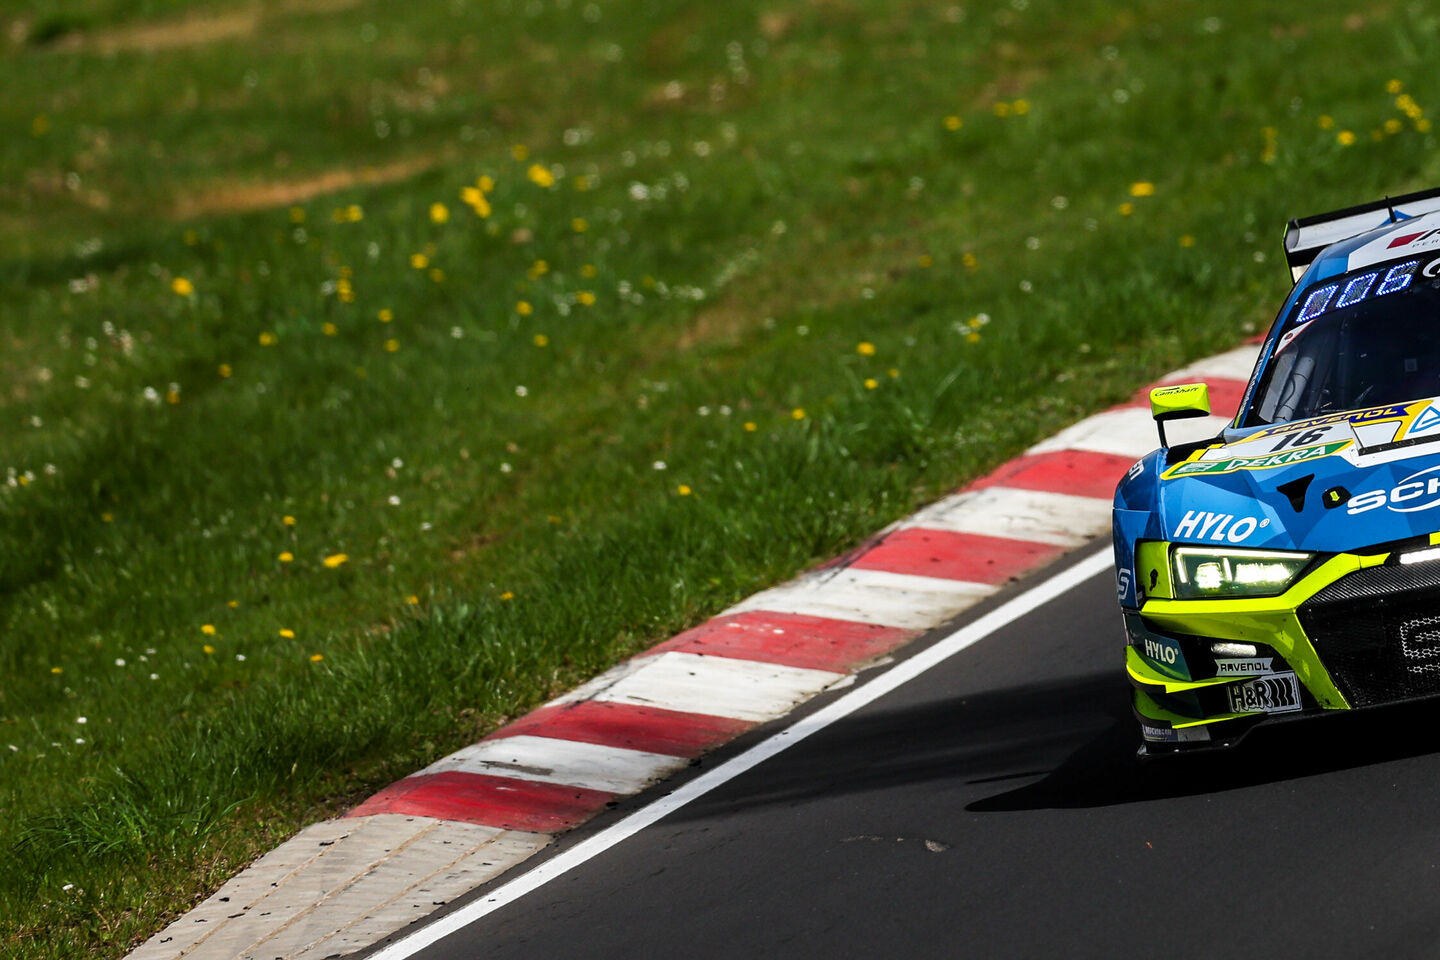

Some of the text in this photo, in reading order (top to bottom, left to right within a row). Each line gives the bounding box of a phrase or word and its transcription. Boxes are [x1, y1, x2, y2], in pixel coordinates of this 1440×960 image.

[1269, 425, 1333, 453] 16
[1226, 445, 1326, 471] DEKRA
[1173, 510, 1258, 543] HYLO
[1144, 638, 1176, 665] HYLO
[1220, 661, 1270, 673] RAVENOL
[1231, 684, 1272, 713] H&R
